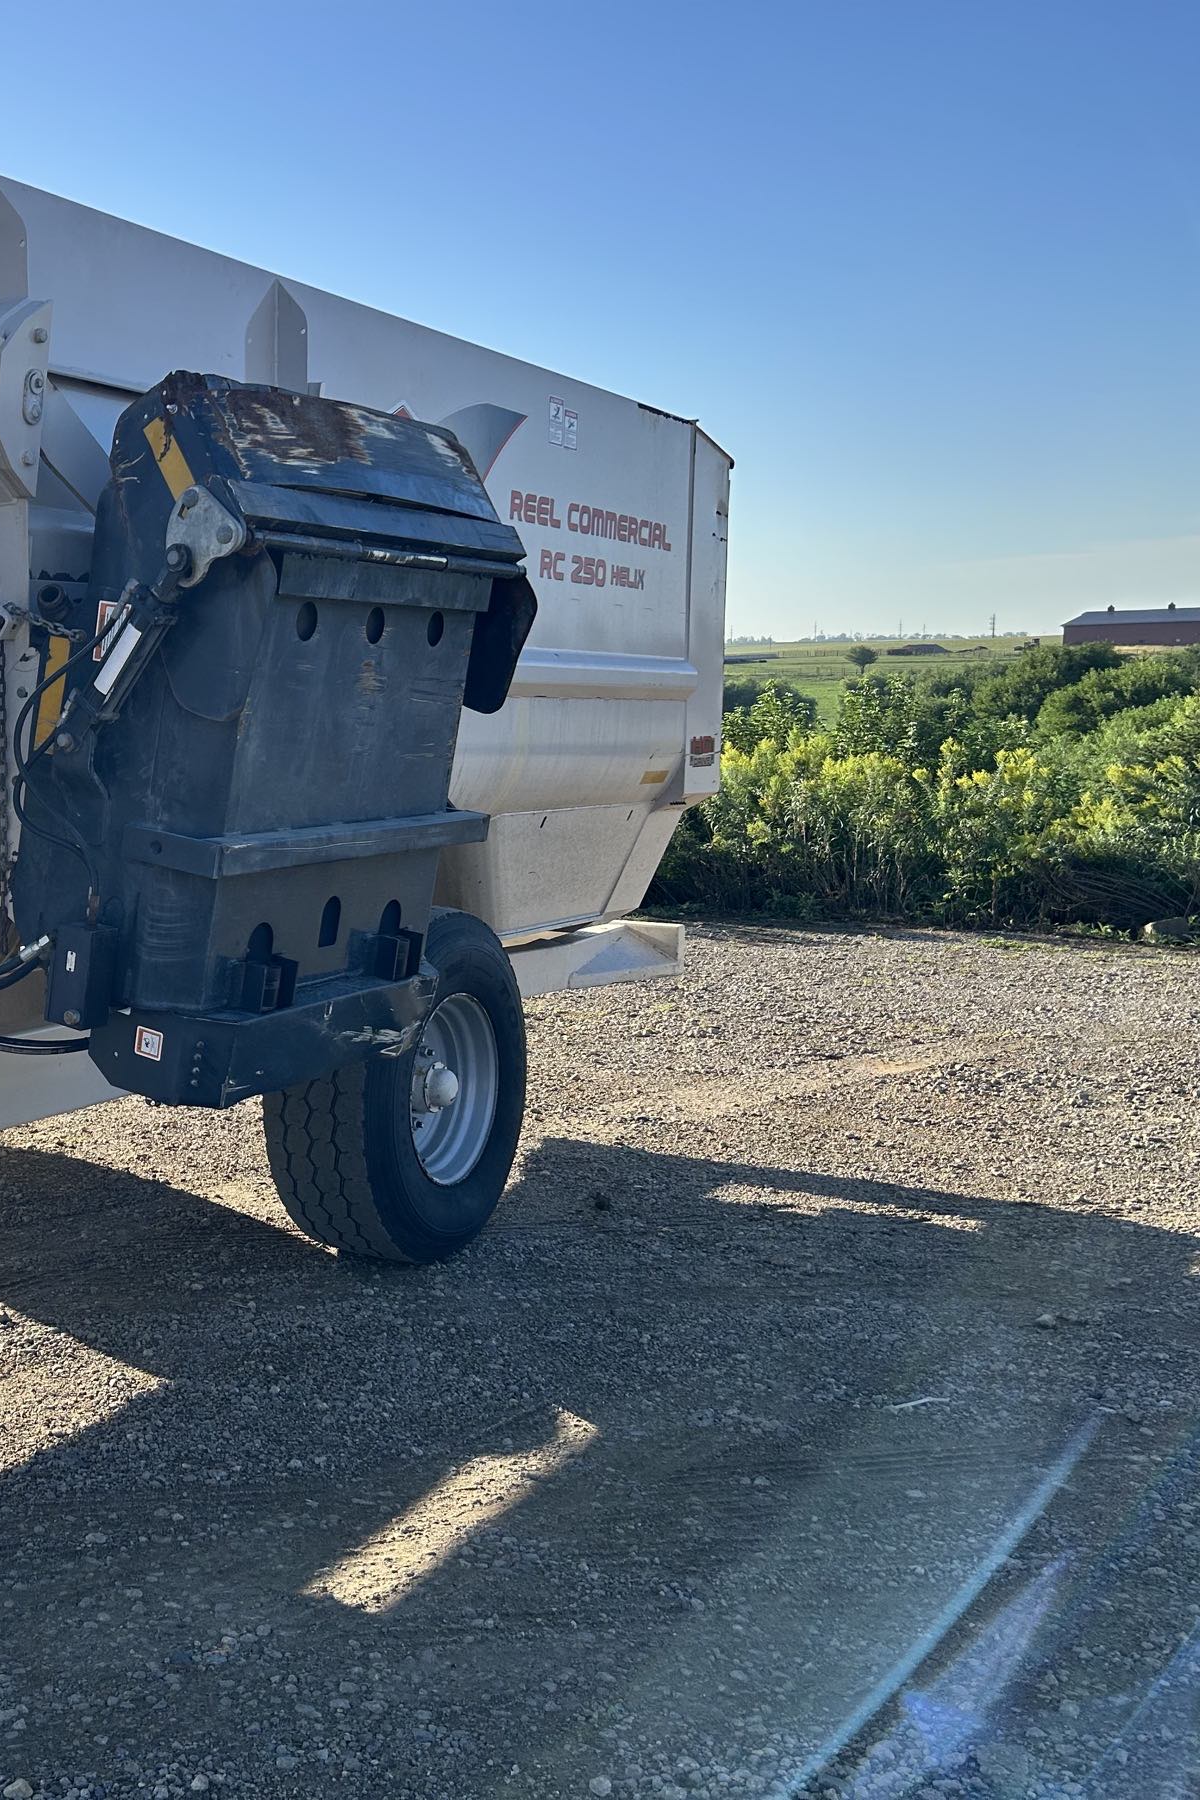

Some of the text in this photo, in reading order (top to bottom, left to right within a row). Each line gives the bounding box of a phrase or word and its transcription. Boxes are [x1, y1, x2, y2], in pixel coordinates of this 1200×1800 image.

[509, 490, 672, 551] REEL COMMERCIAL
[539, 549, 646, 590] RC 250 HELIX
